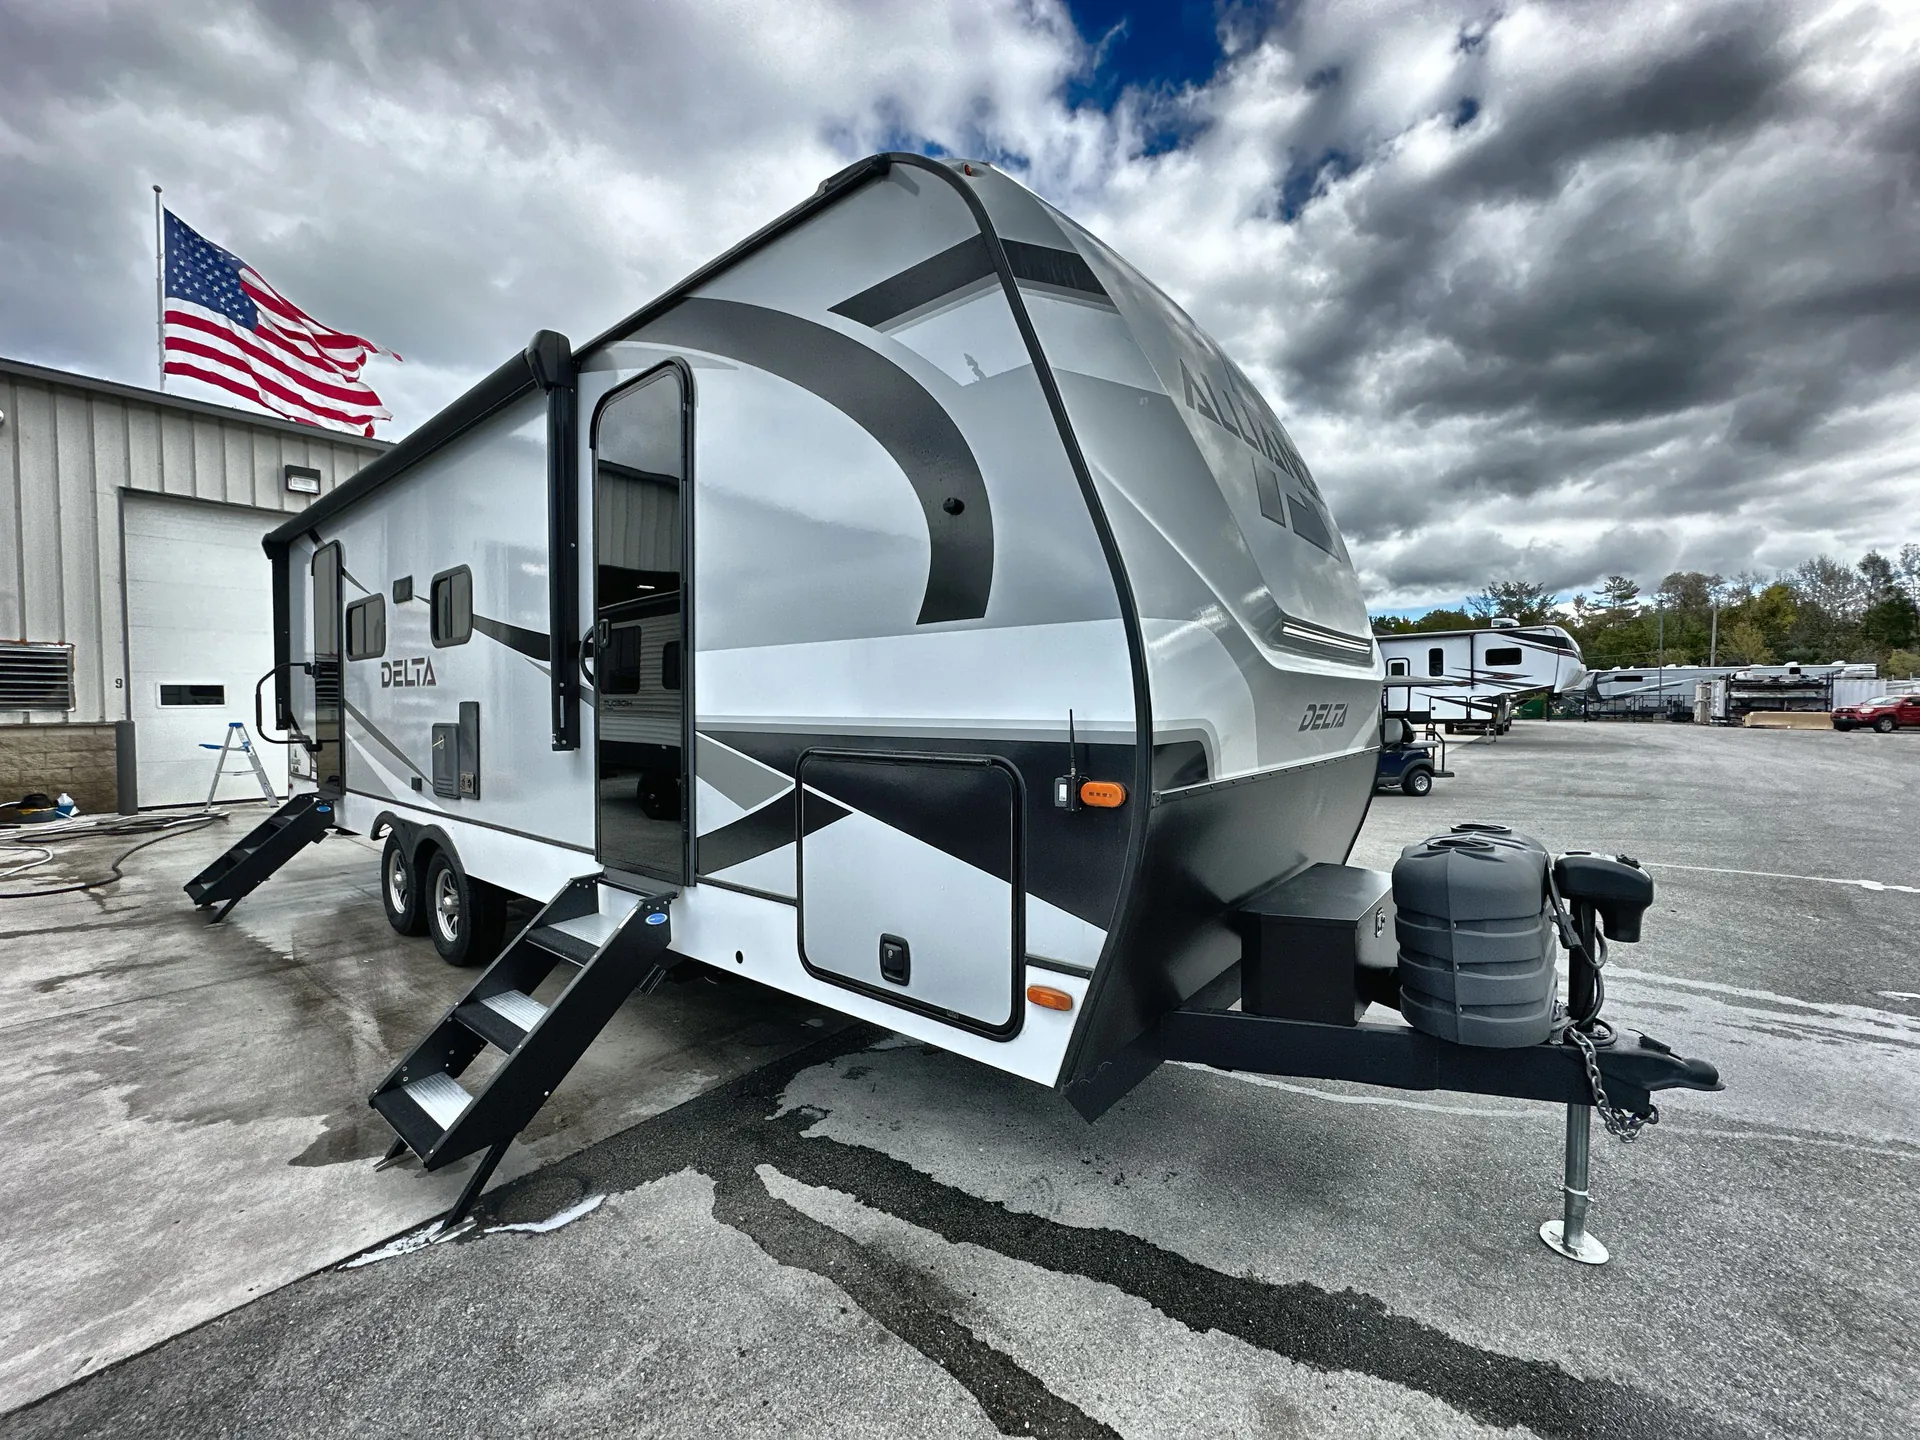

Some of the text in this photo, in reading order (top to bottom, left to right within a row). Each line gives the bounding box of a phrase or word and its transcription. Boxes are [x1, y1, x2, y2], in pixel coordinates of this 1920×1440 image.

[115, 678, 123, 689] 9
[381, 656, 437, 688] DELTA
[1298, 703, 1349, 732] DELTA
